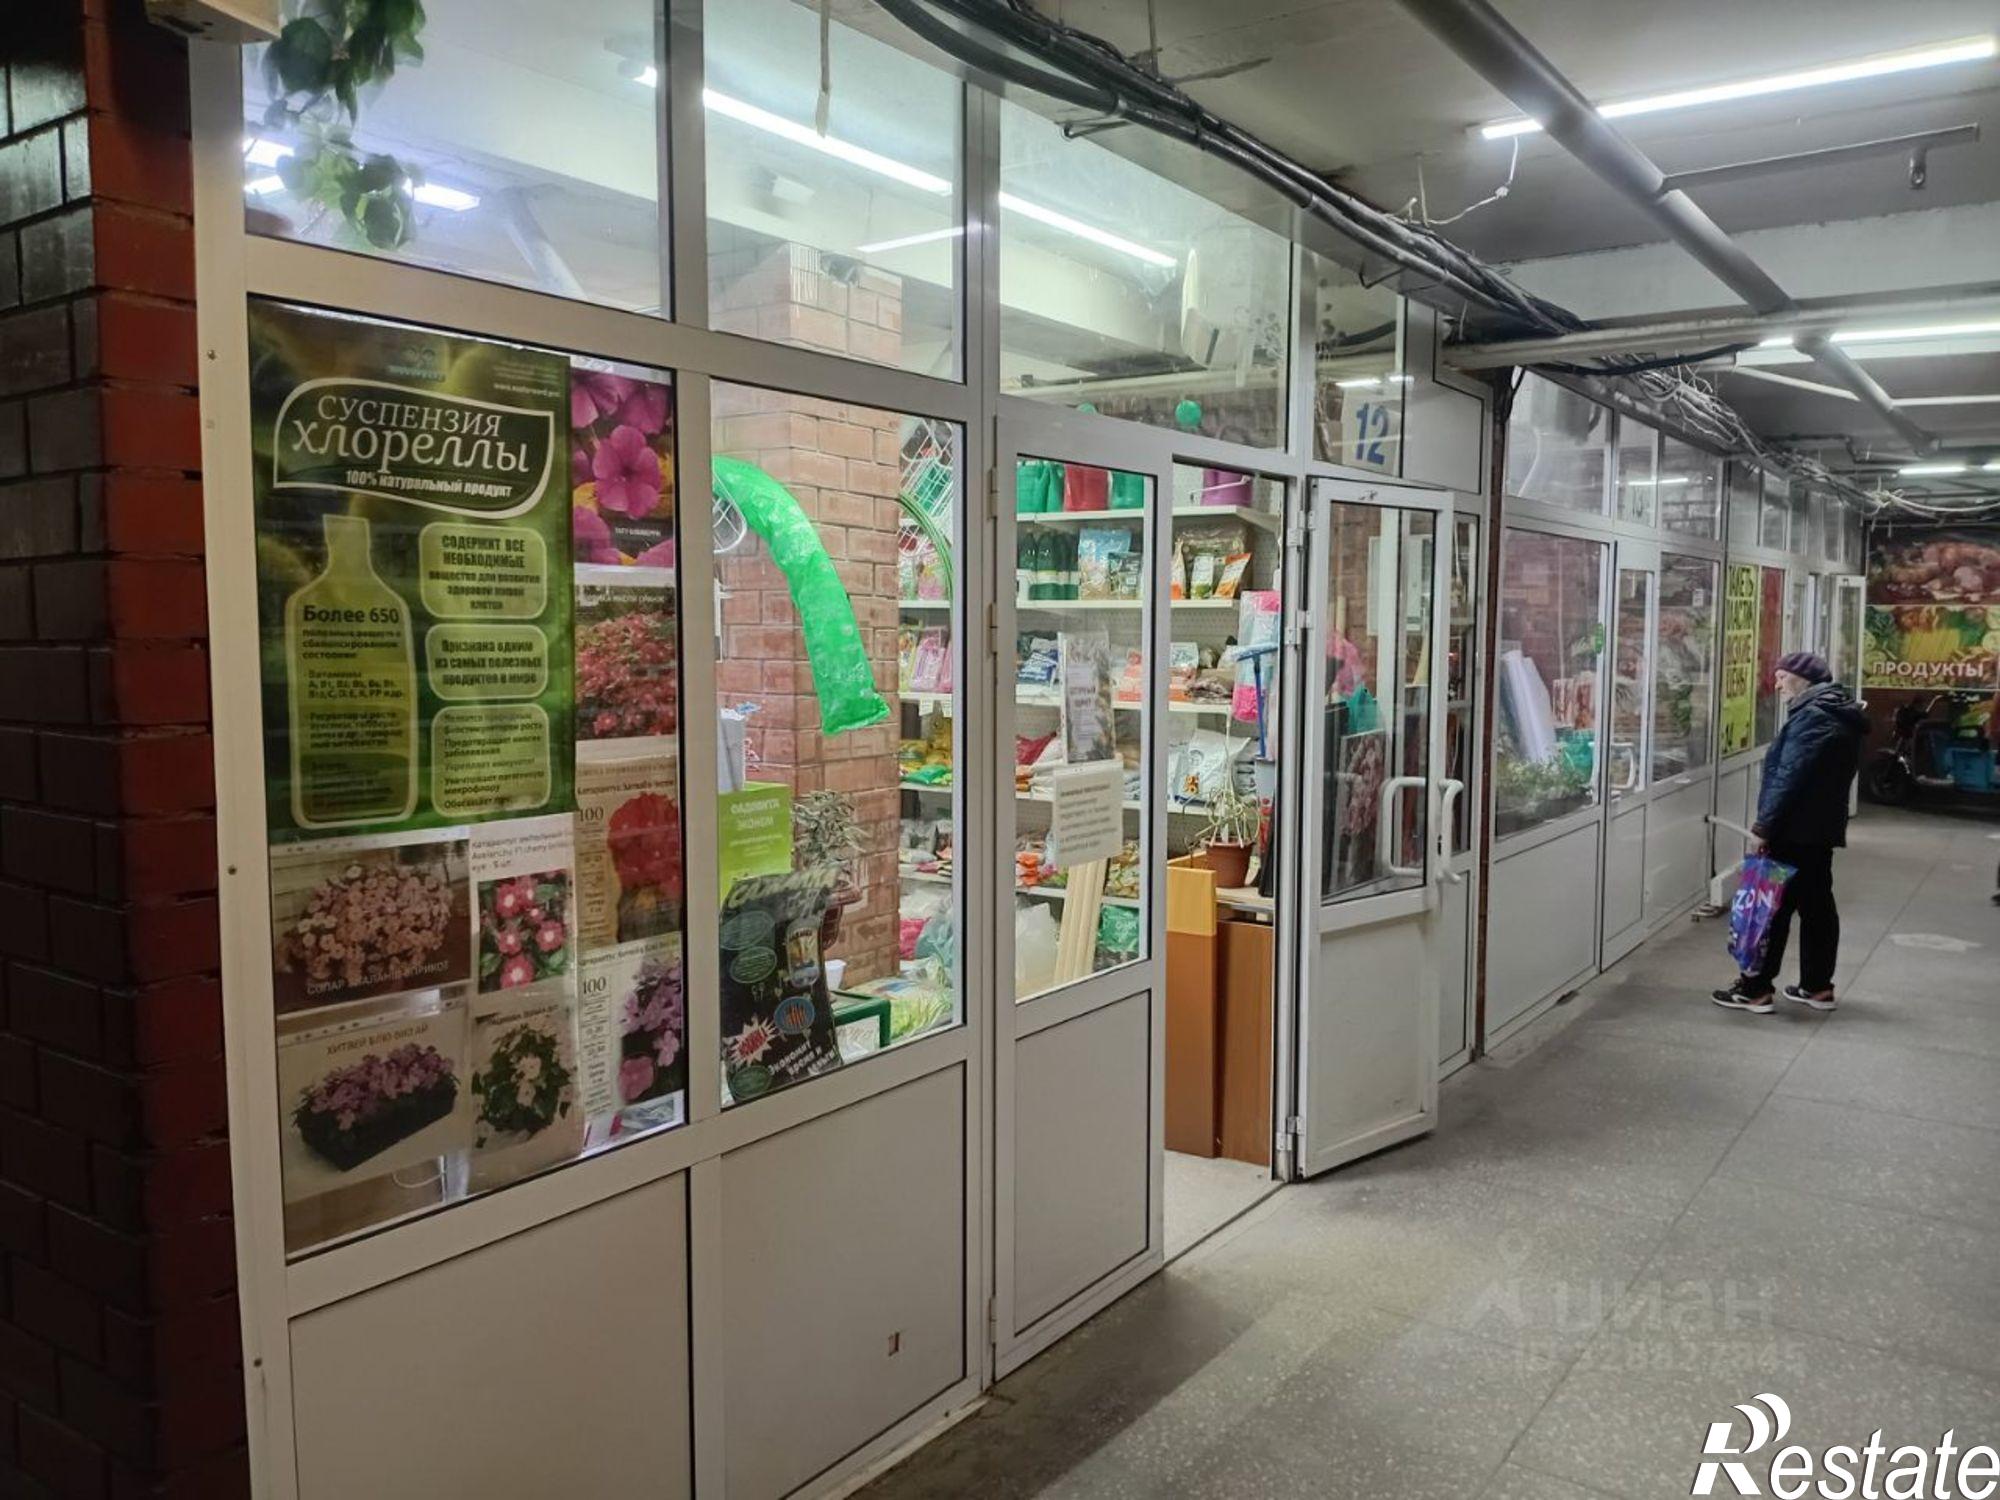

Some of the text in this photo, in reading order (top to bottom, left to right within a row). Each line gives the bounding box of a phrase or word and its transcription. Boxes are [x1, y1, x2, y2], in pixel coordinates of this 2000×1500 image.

[317, 394, 502, 437] СУСПЕНЗИЯ
[1355, 402, 1389, 465] 12
[345, 470, 513, 498] 100% натуральный продукт
[441, 535, 525, 552] СОДЕРЖИТ ВСЕ
[442, 551, 525, 569] НЕОБХОДИМЫЕ
[303, 605, 400, 623] Более 650
[1872, 661, 1984, 678] ПРОДУКТЫ
[580, 806, 604, 822] 100
[583, 976, 607, 995] 100
